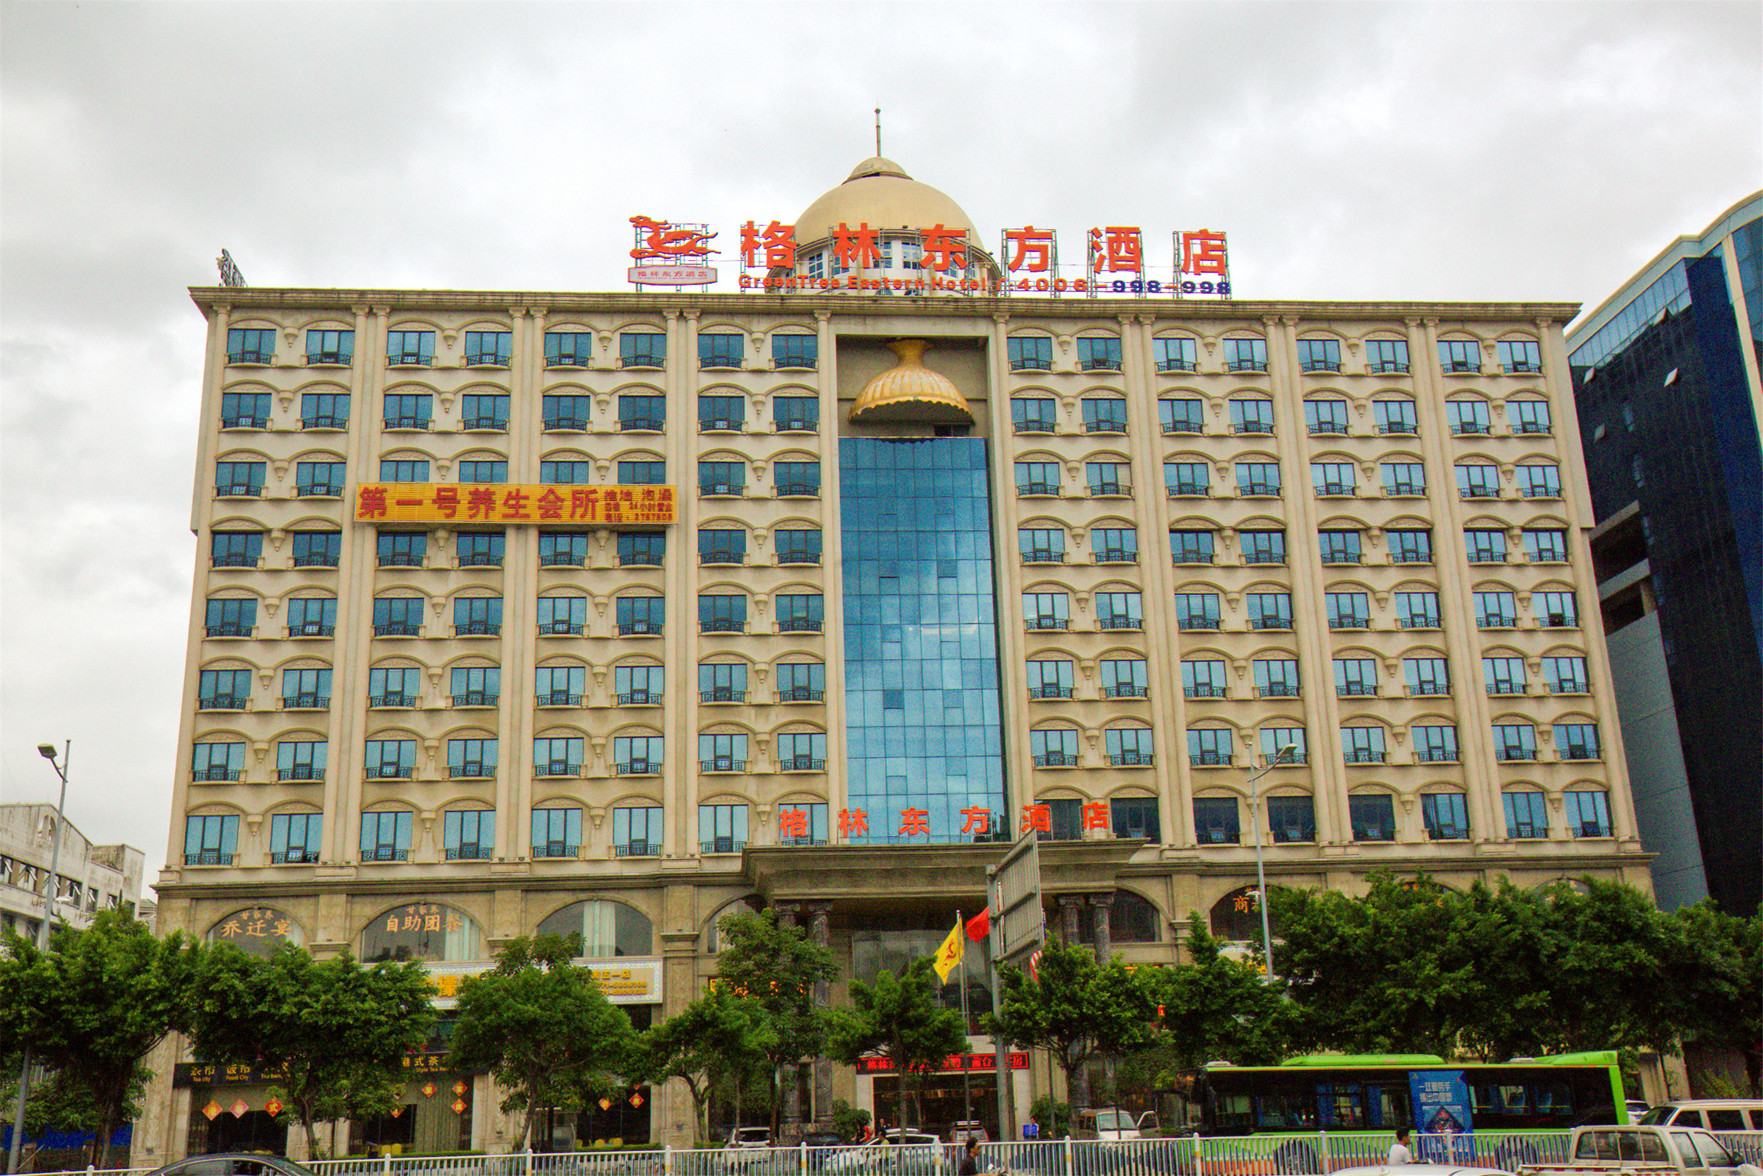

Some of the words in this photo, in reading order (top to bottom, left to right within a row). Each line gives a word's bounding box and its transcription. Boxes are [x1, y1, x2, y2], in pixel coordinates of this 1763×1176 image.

[740, 220, 1227, 276] 格林东方酒店
[738, 274, 841, 289] GreenTree
[847, 275, 925, 290] Eastern
[932, 277, 986, 291] Hotel
[358, 486, 600, 520] 第一号养生会所
[779, 801, 1109, 837] 格林东方酒店
[220, 919, 292, 938] 乔迁宴
[386, 913, 465, 933] 自助团餐
